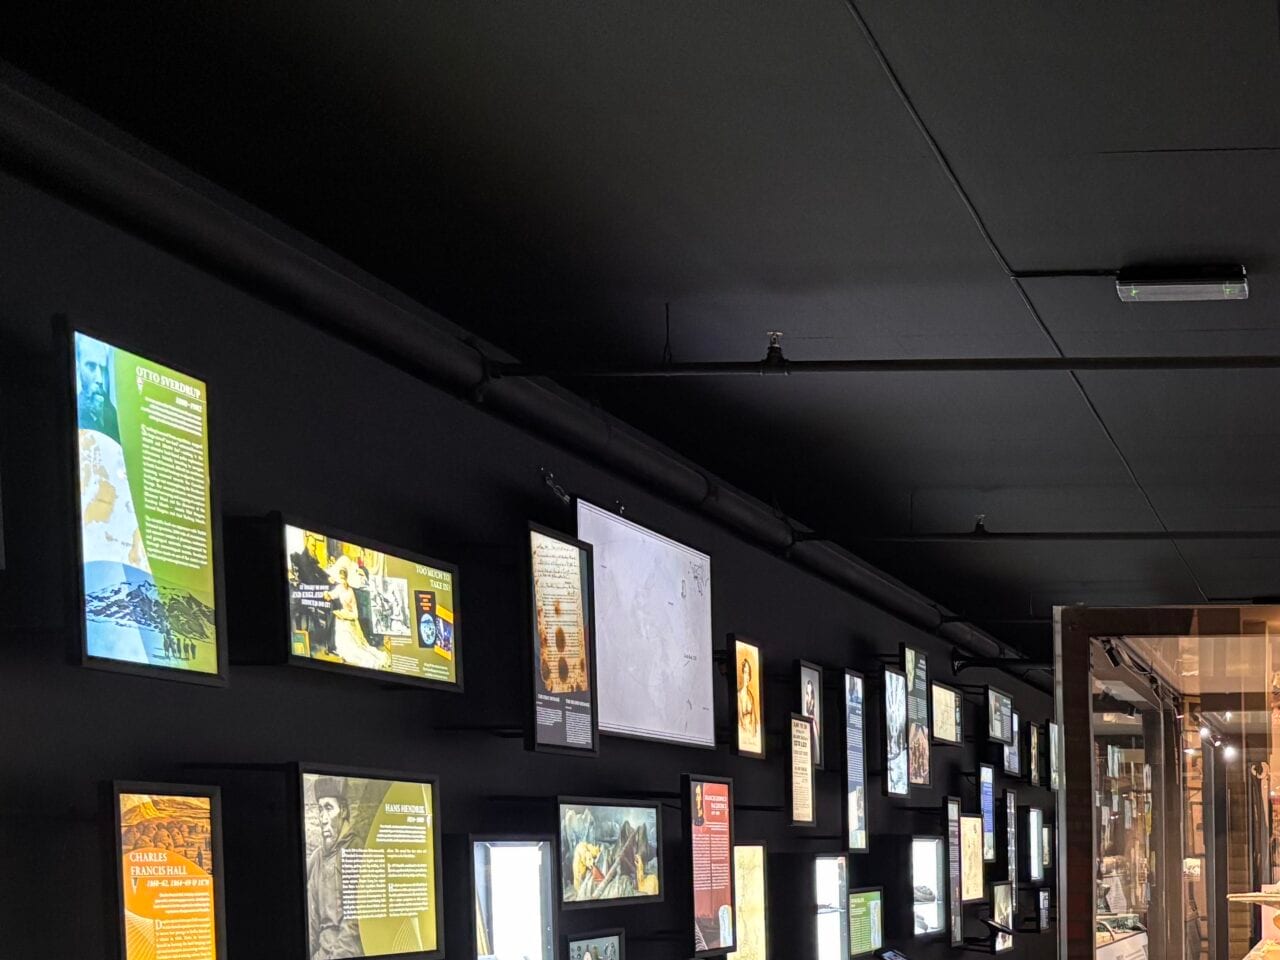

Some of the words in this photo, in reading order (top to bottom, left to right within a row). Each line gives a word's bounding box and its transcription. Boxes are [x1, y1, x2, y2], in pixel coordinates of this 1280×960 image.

[136, 366, 160, 383] OTTO
[160, 375, 201, 398] SVERDRUP
[385, 803, 400, 812] HANS
[130, 852, 167, 862] CHARLES
[131, 866, 165, 876] FRANCIS
[167, 866, 187, 875] HALL
